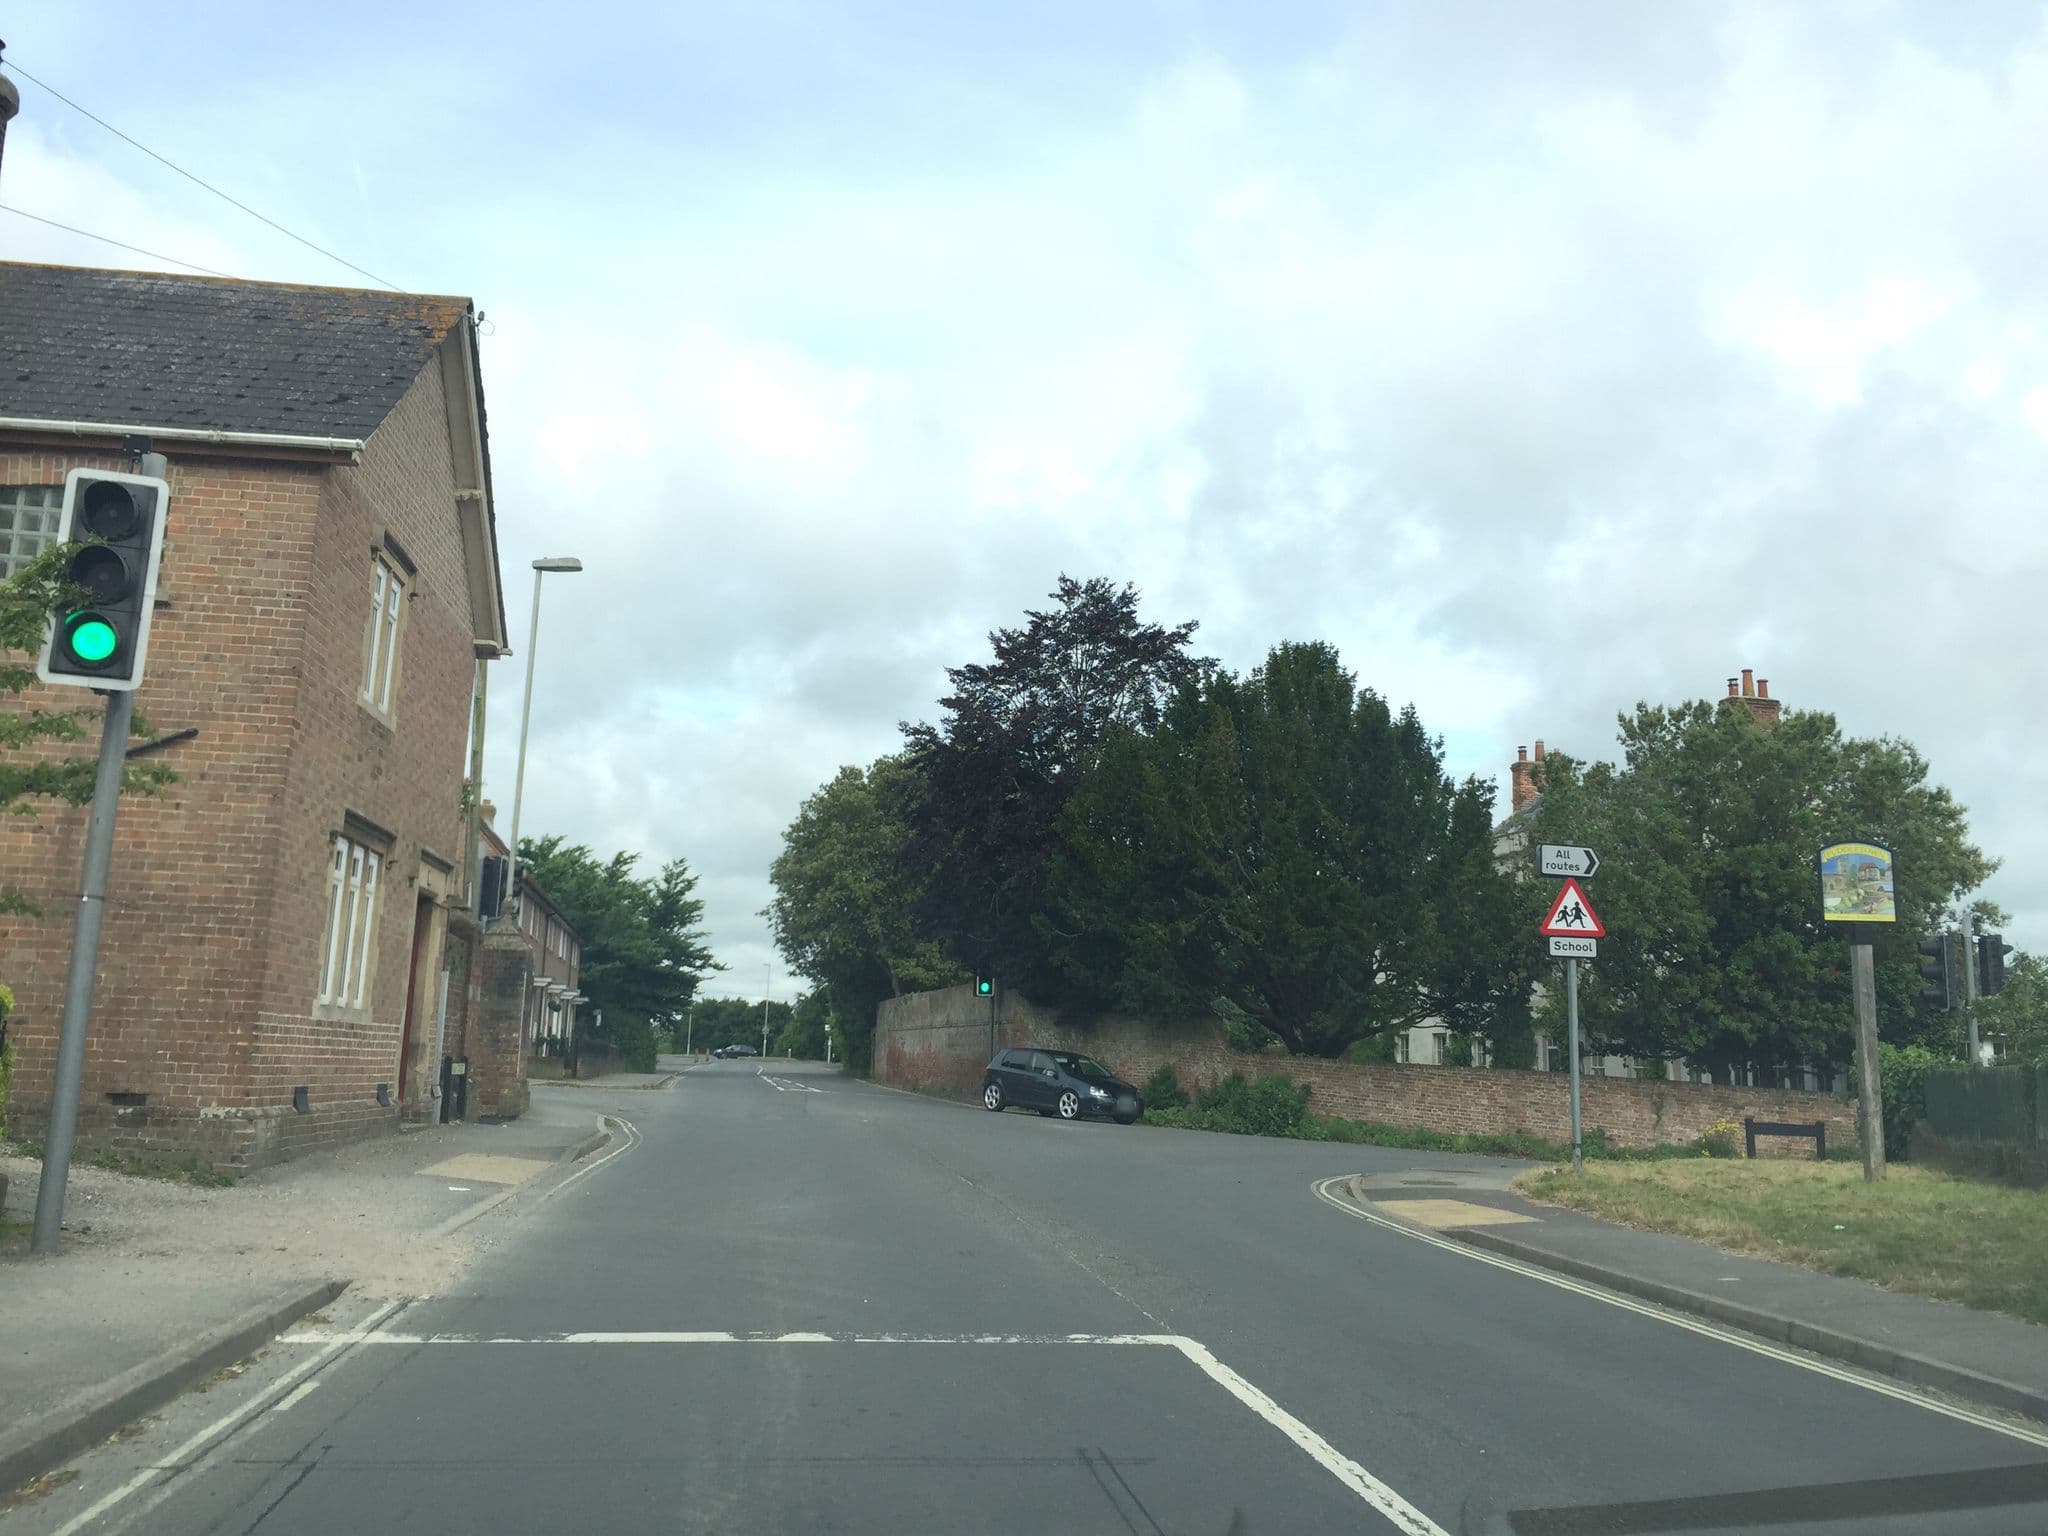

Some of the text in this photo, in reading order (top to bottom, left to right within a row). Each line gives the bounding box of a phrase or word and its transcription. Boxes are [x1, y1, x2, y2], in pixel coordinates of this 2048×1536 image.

[1555, 850, 1570, 859] All
[1546, 862, 1580, 871] routes
[1554, 941, 1593, 952] School
